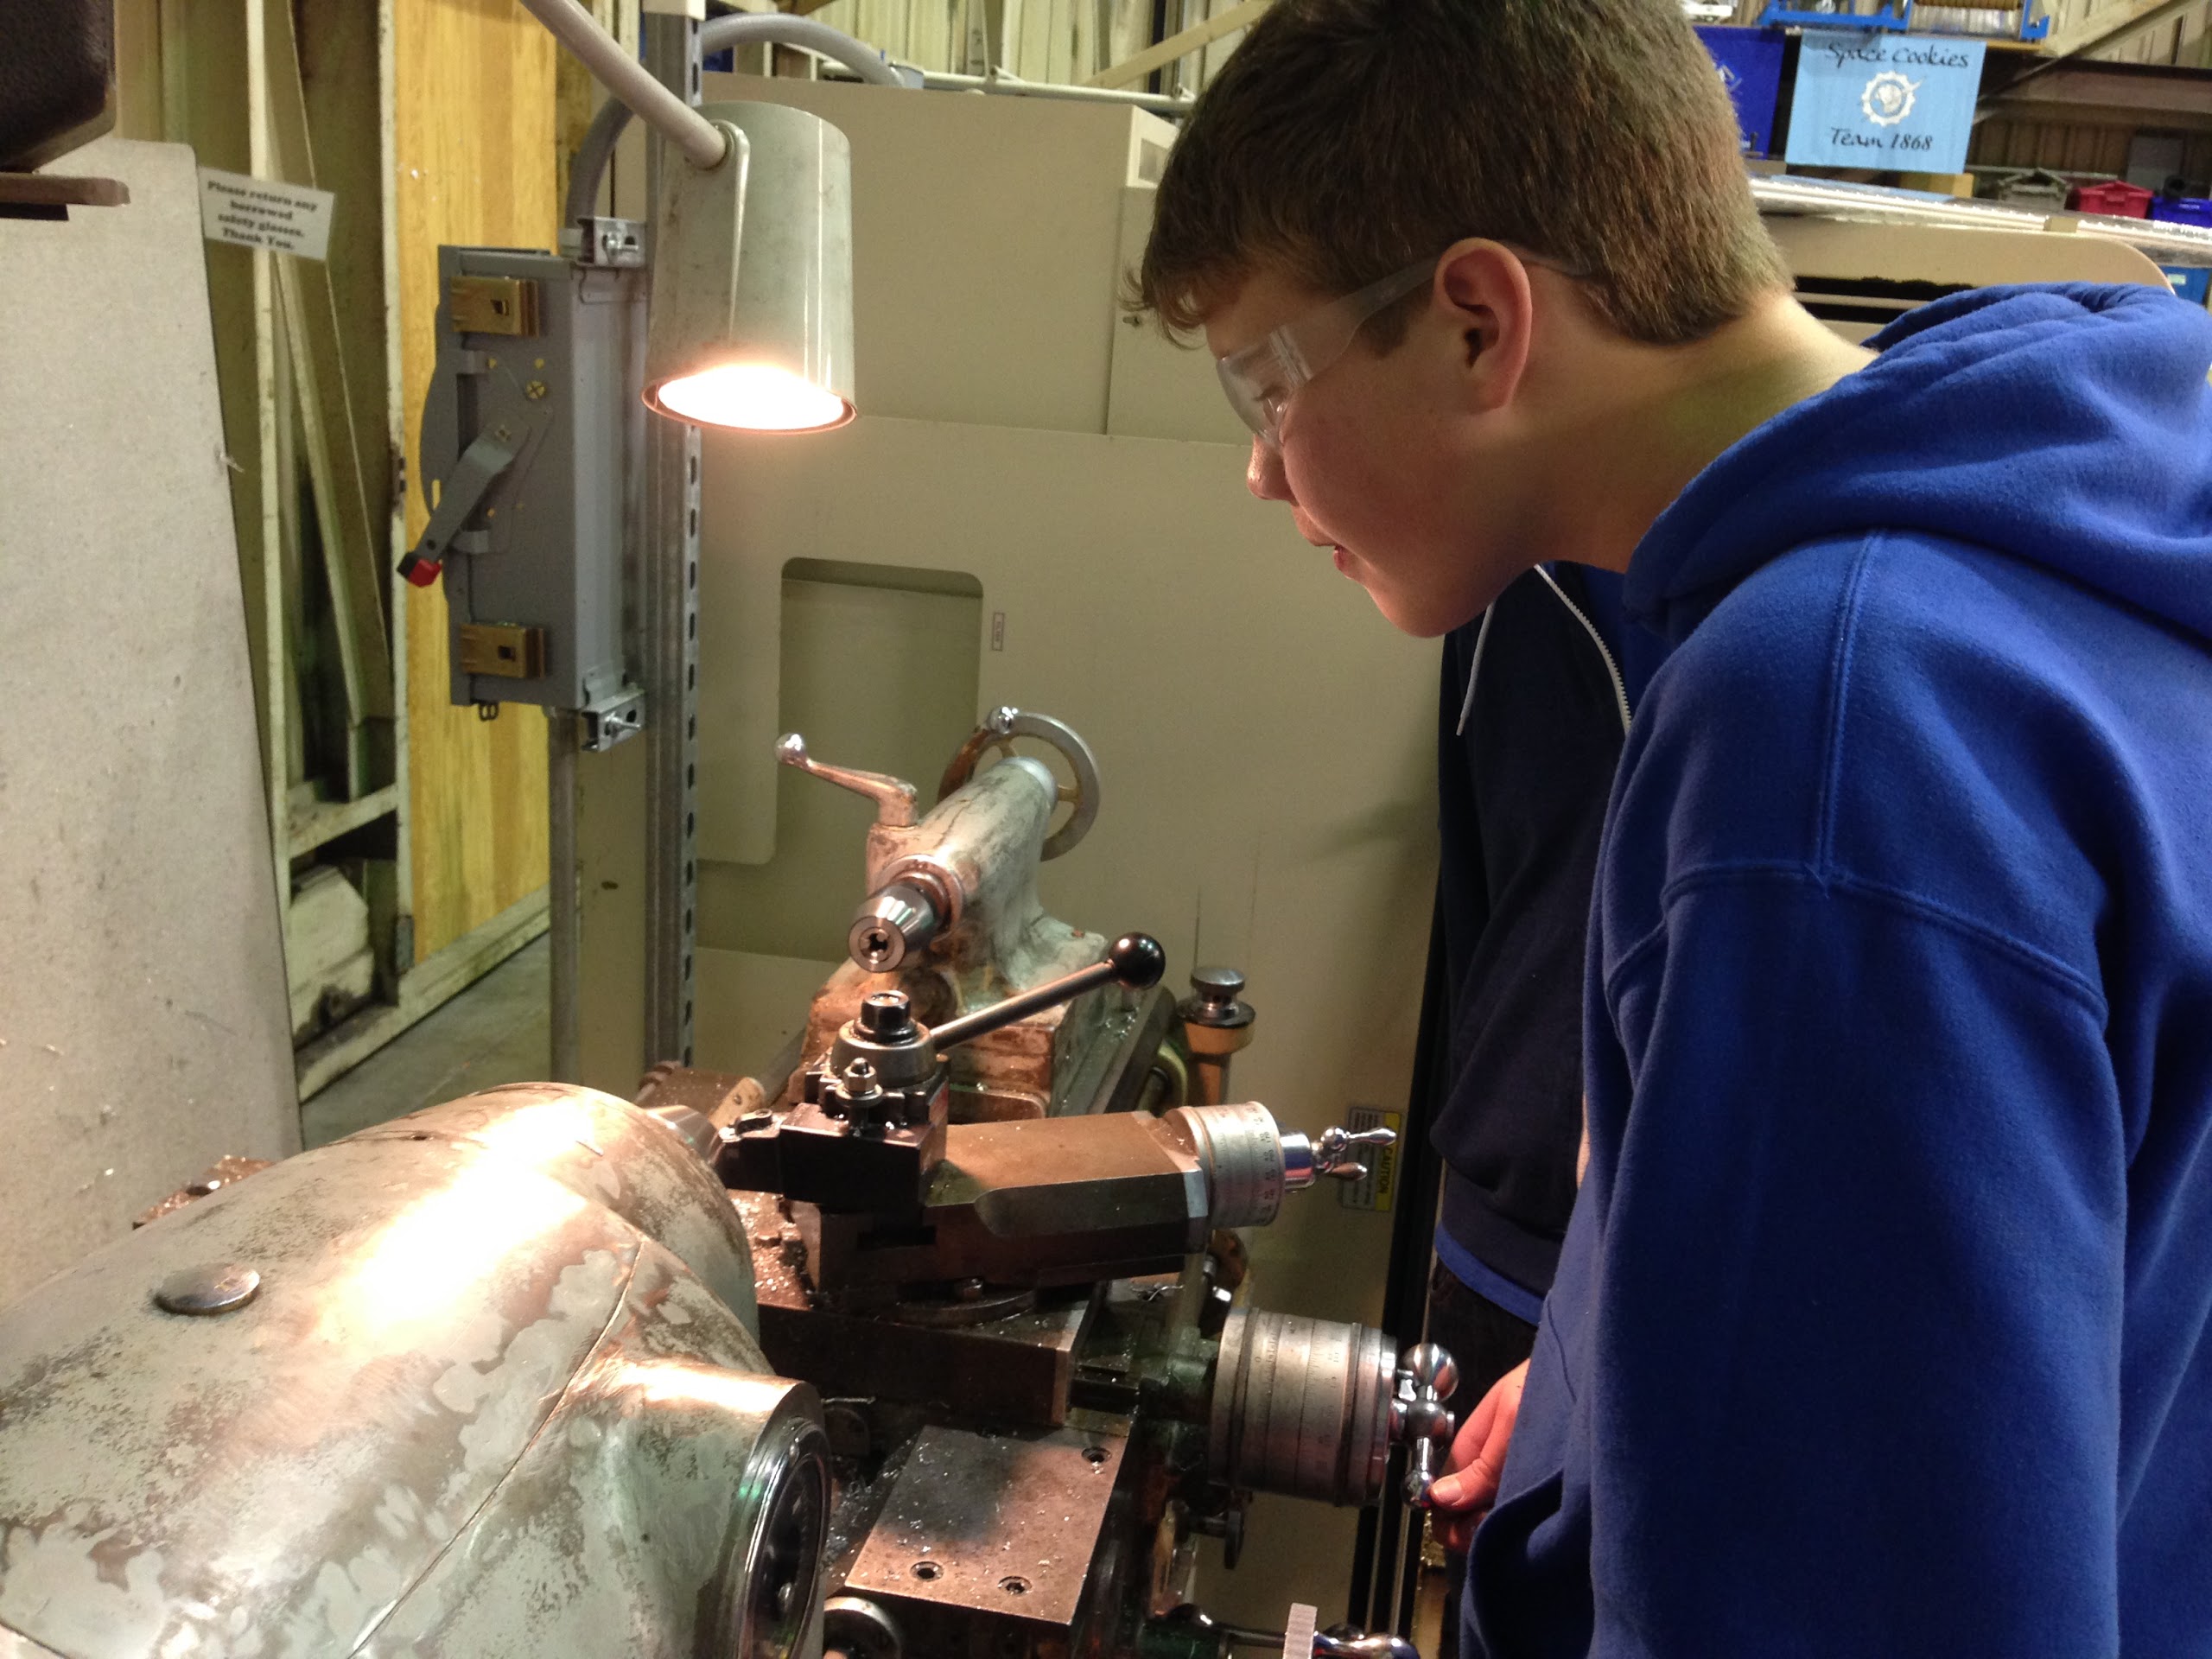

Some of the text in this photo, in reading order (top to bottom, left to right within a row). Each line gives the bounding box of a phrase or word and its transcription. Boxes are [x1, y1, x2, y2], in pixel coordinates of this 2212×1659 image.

[1825, 41, 1969, 69] Space Cookies
[1830, 127, 1934, 151] Team 1868
[207, 180, 317, 213] Please return any
[218, 213, 255, 228] safety
[231, 200, 293, 219] borrowed
[223, 226, 262, 243] Thank
[1379, 1147, 1394, 1194] CAUTION
